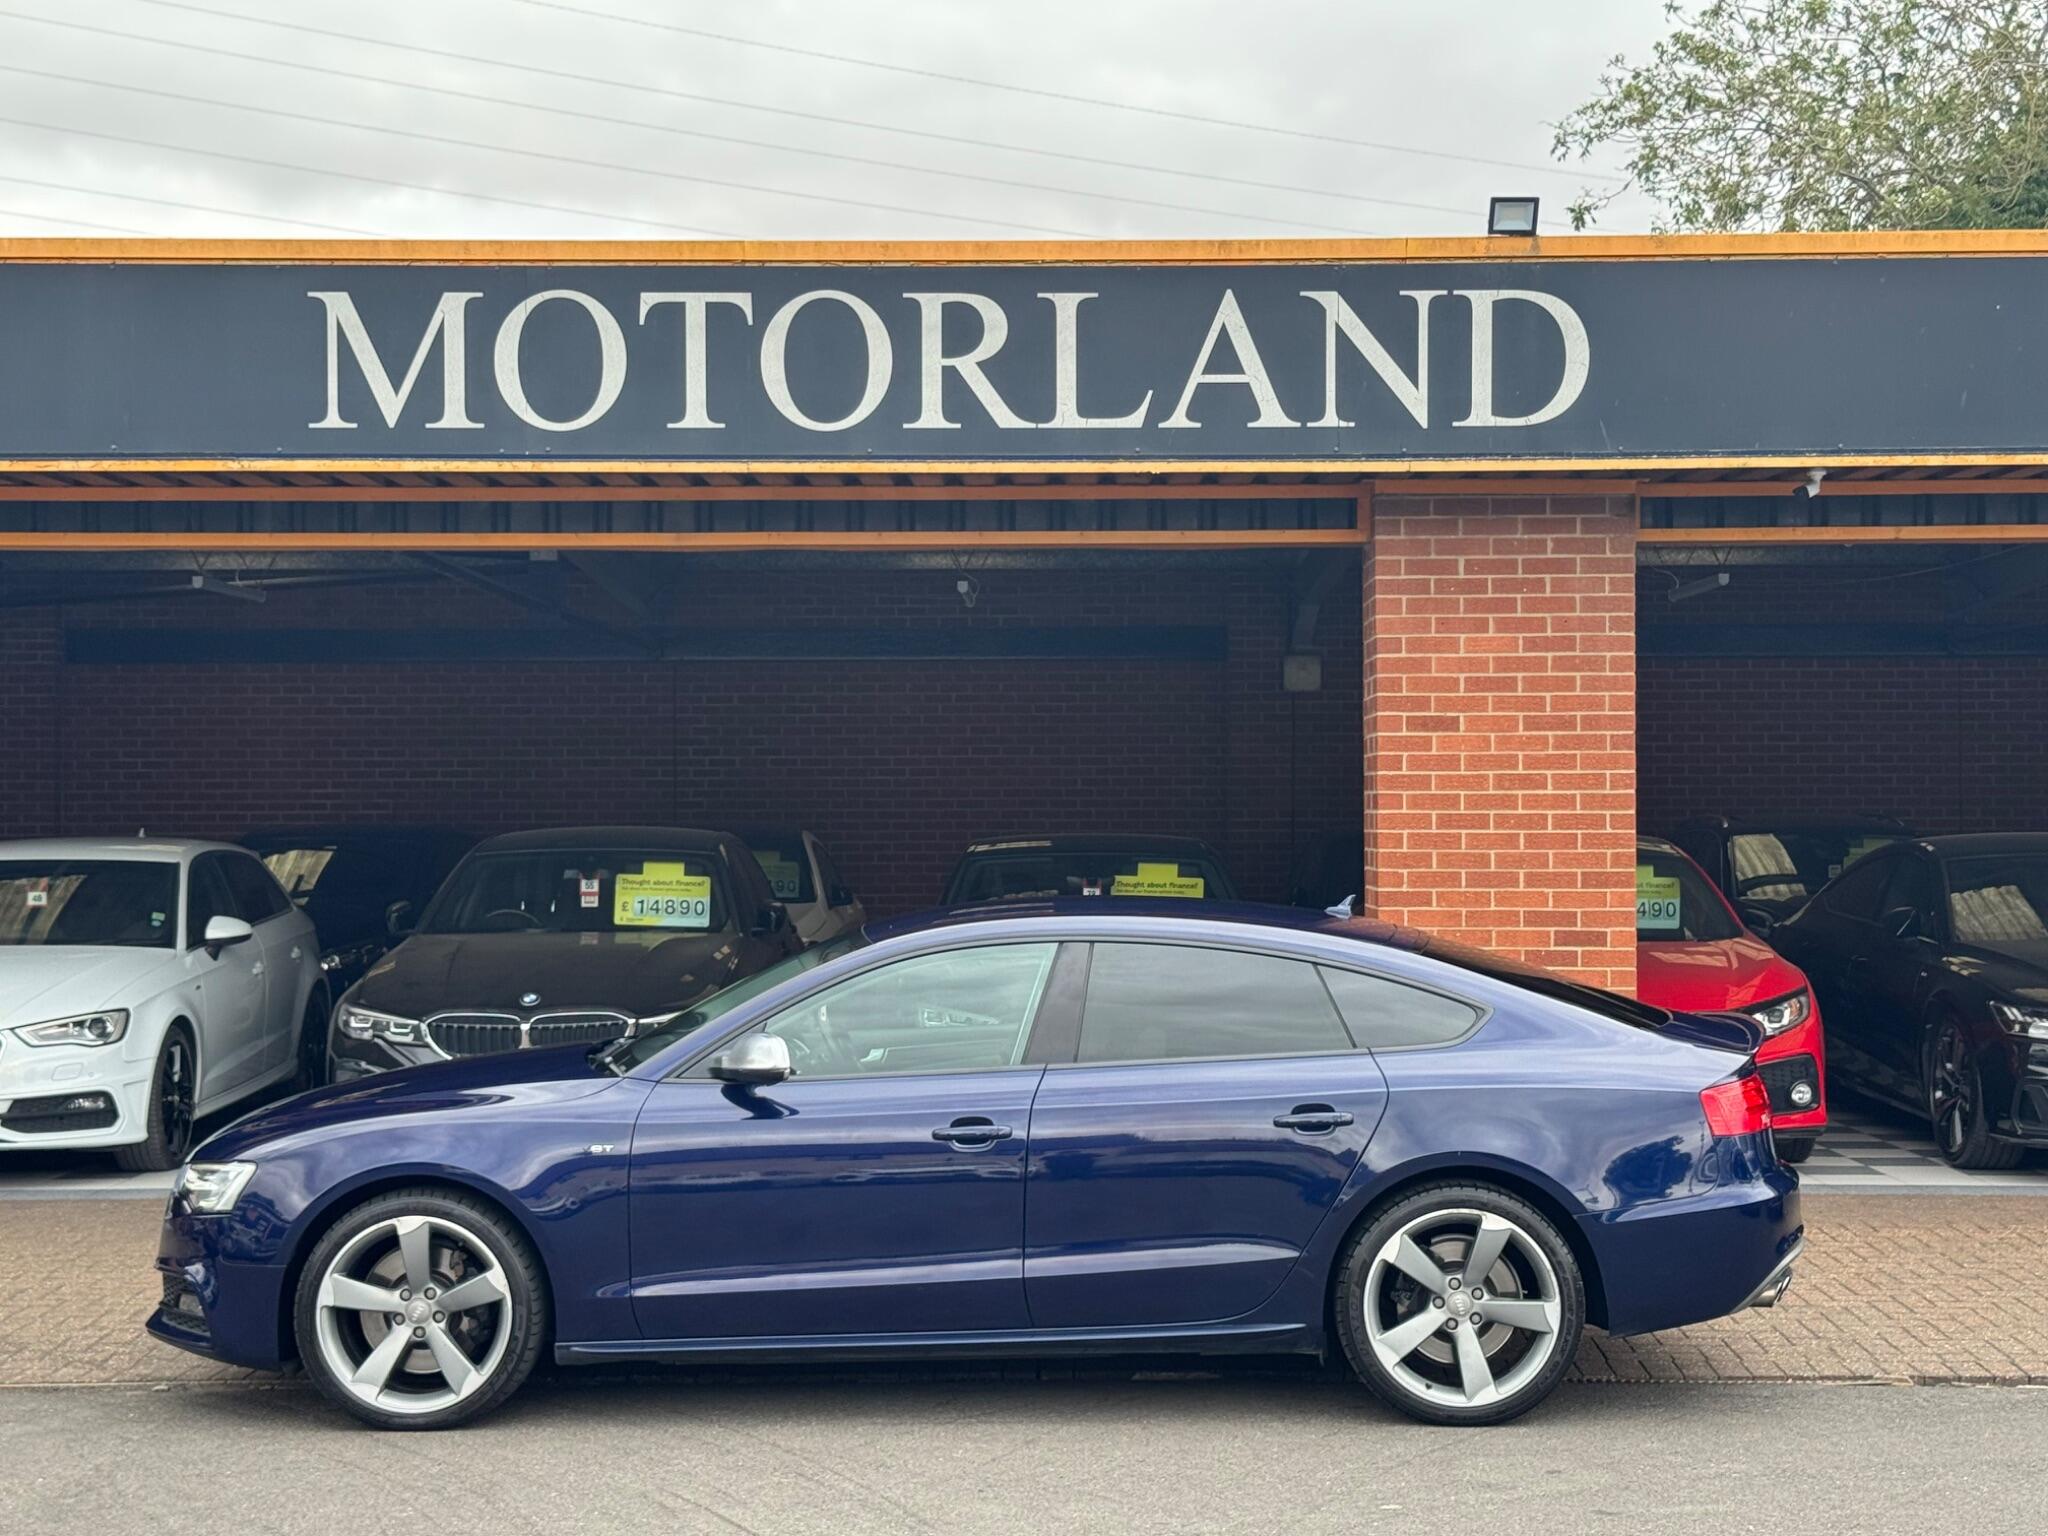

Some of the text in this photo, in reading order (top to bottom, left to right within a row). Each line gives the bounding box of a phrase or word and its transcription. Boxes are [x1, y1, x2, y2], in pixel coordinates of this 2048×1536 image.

[307, 288, 1592, 432] MOTORLAND
[621, 878, 651, 887] Thought
[653, 879, 674, 887] about
[1117, 881, 1145, 889] Thought
[637, 899, 706, 916] 14890
[1637, 901, 1677, 918] 490
